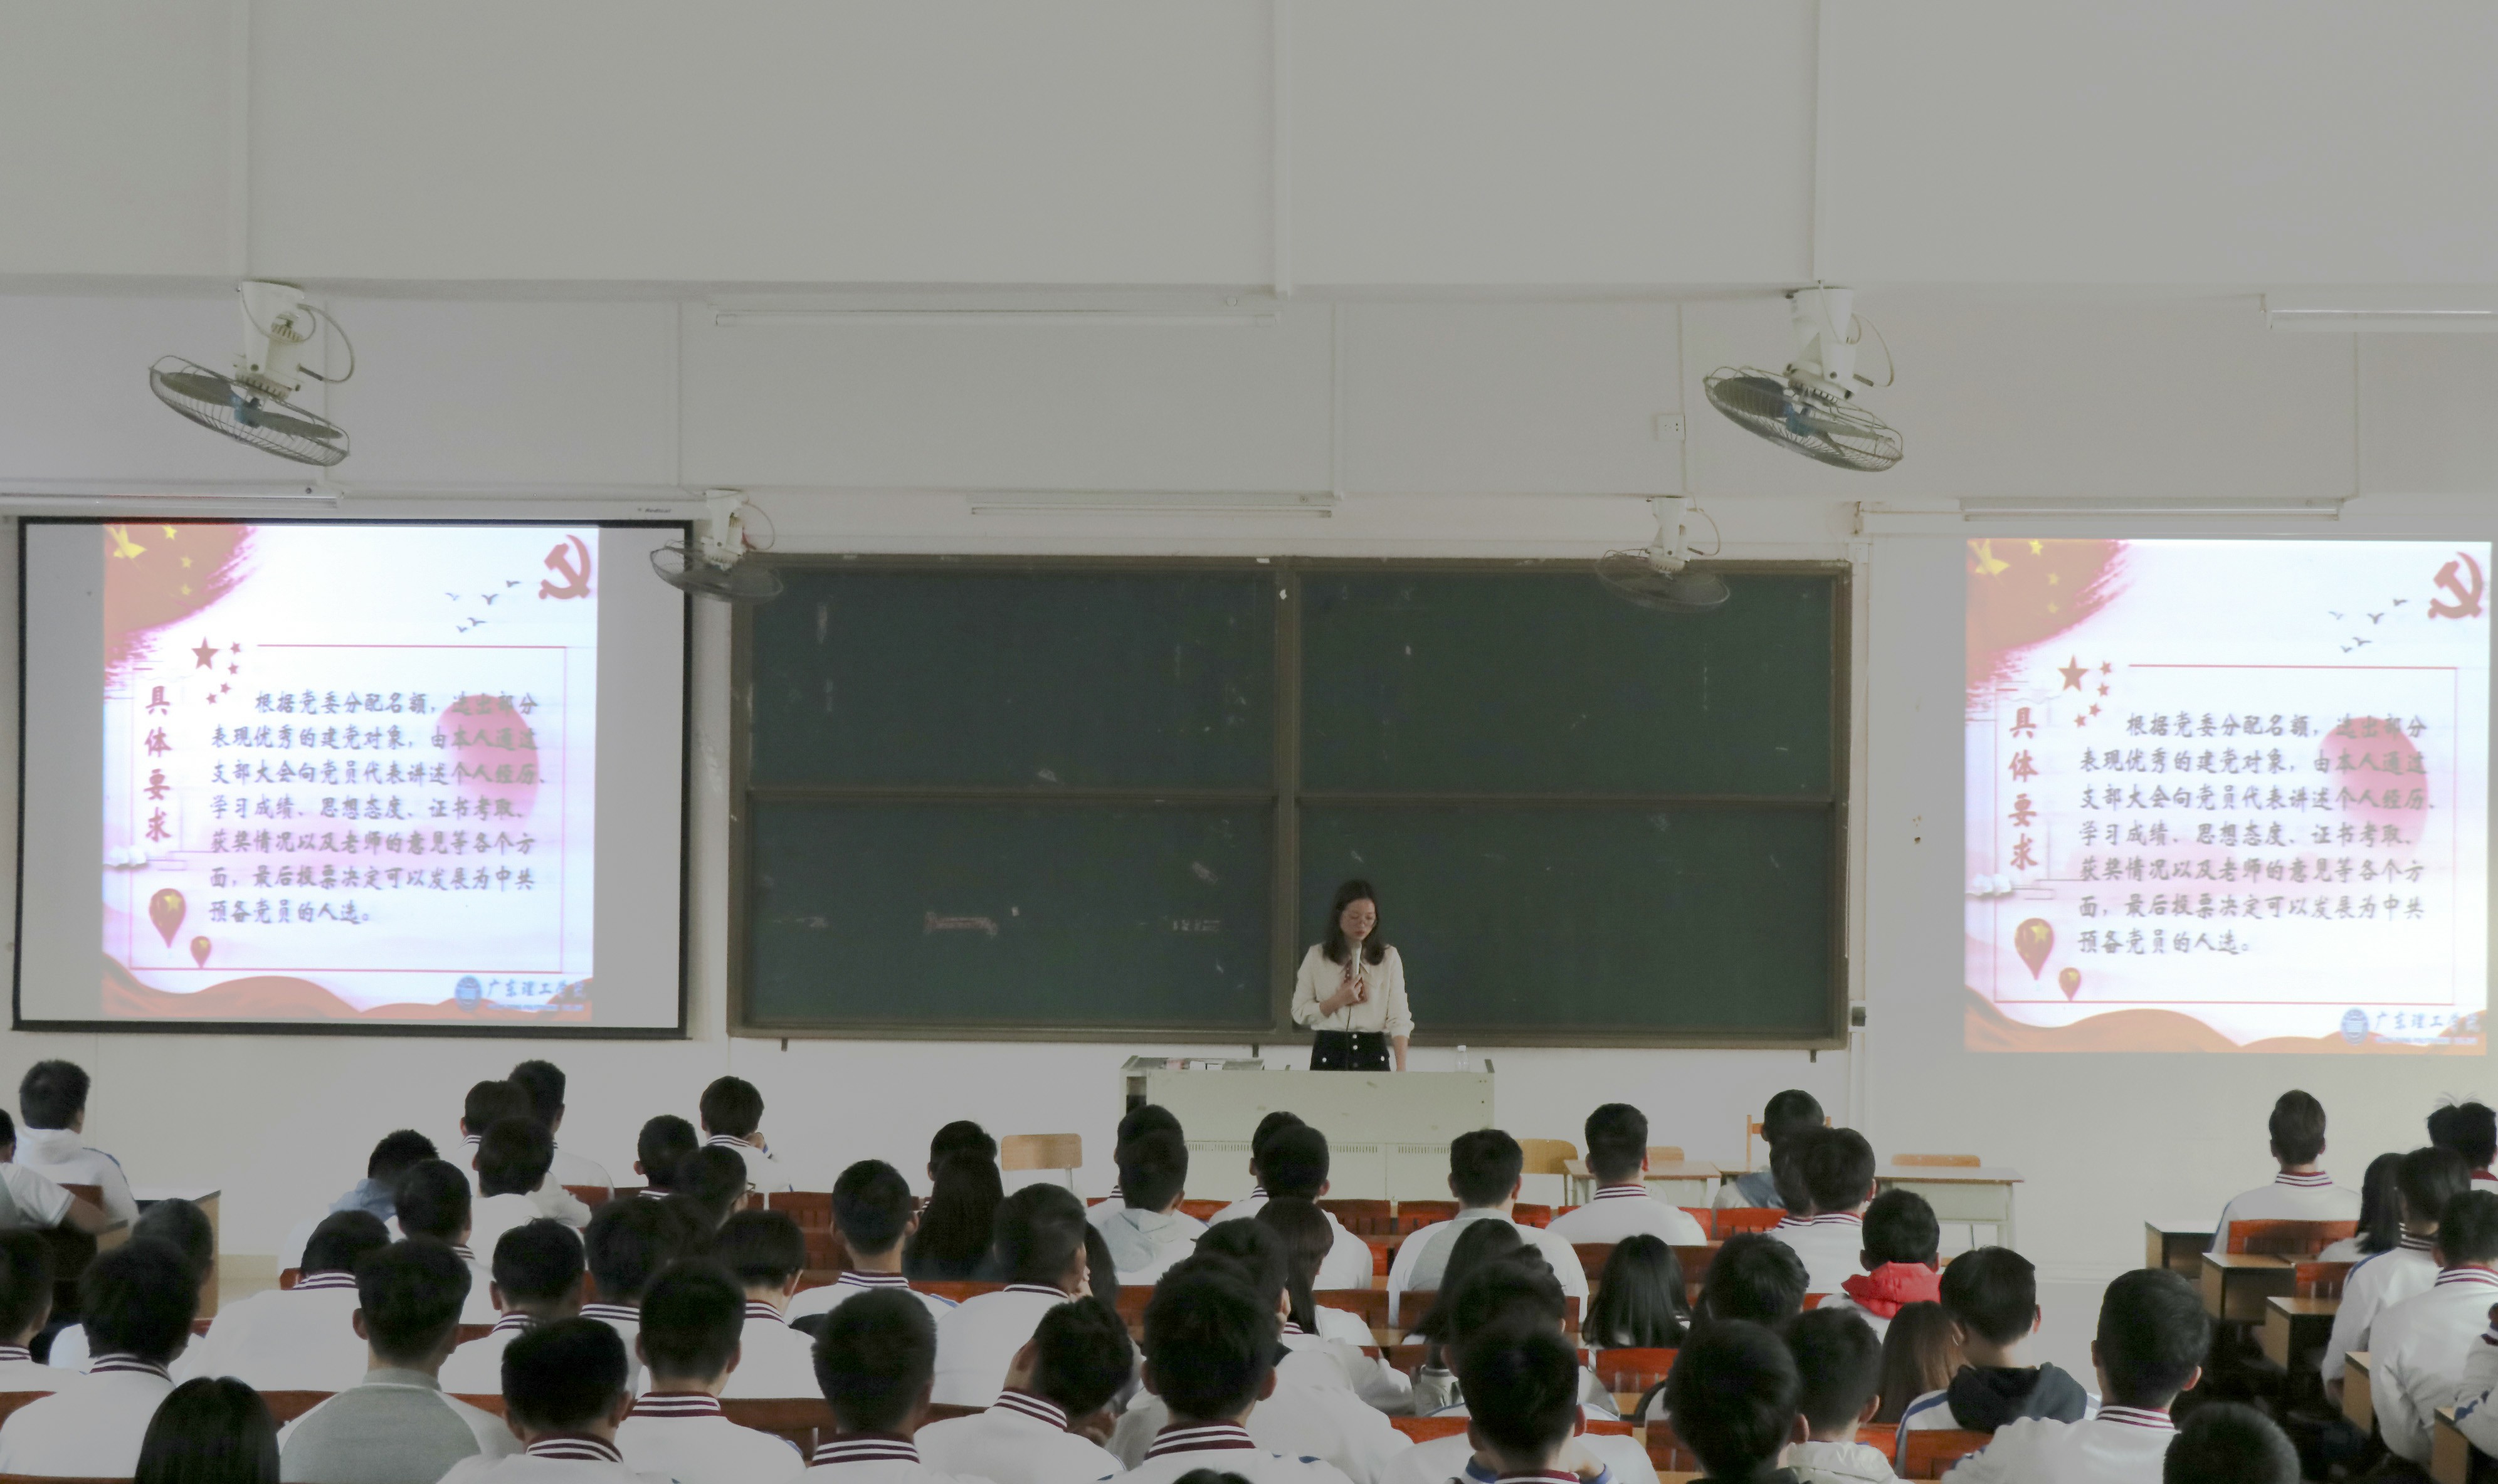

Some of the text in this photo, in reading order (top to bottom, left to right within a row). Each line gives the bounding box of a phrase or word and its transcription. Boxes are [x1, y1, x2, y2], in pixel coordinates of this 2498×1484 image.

[145, 685, 172, 843] 具体要求
[2008, 707, 2038, 870] 具体要求
